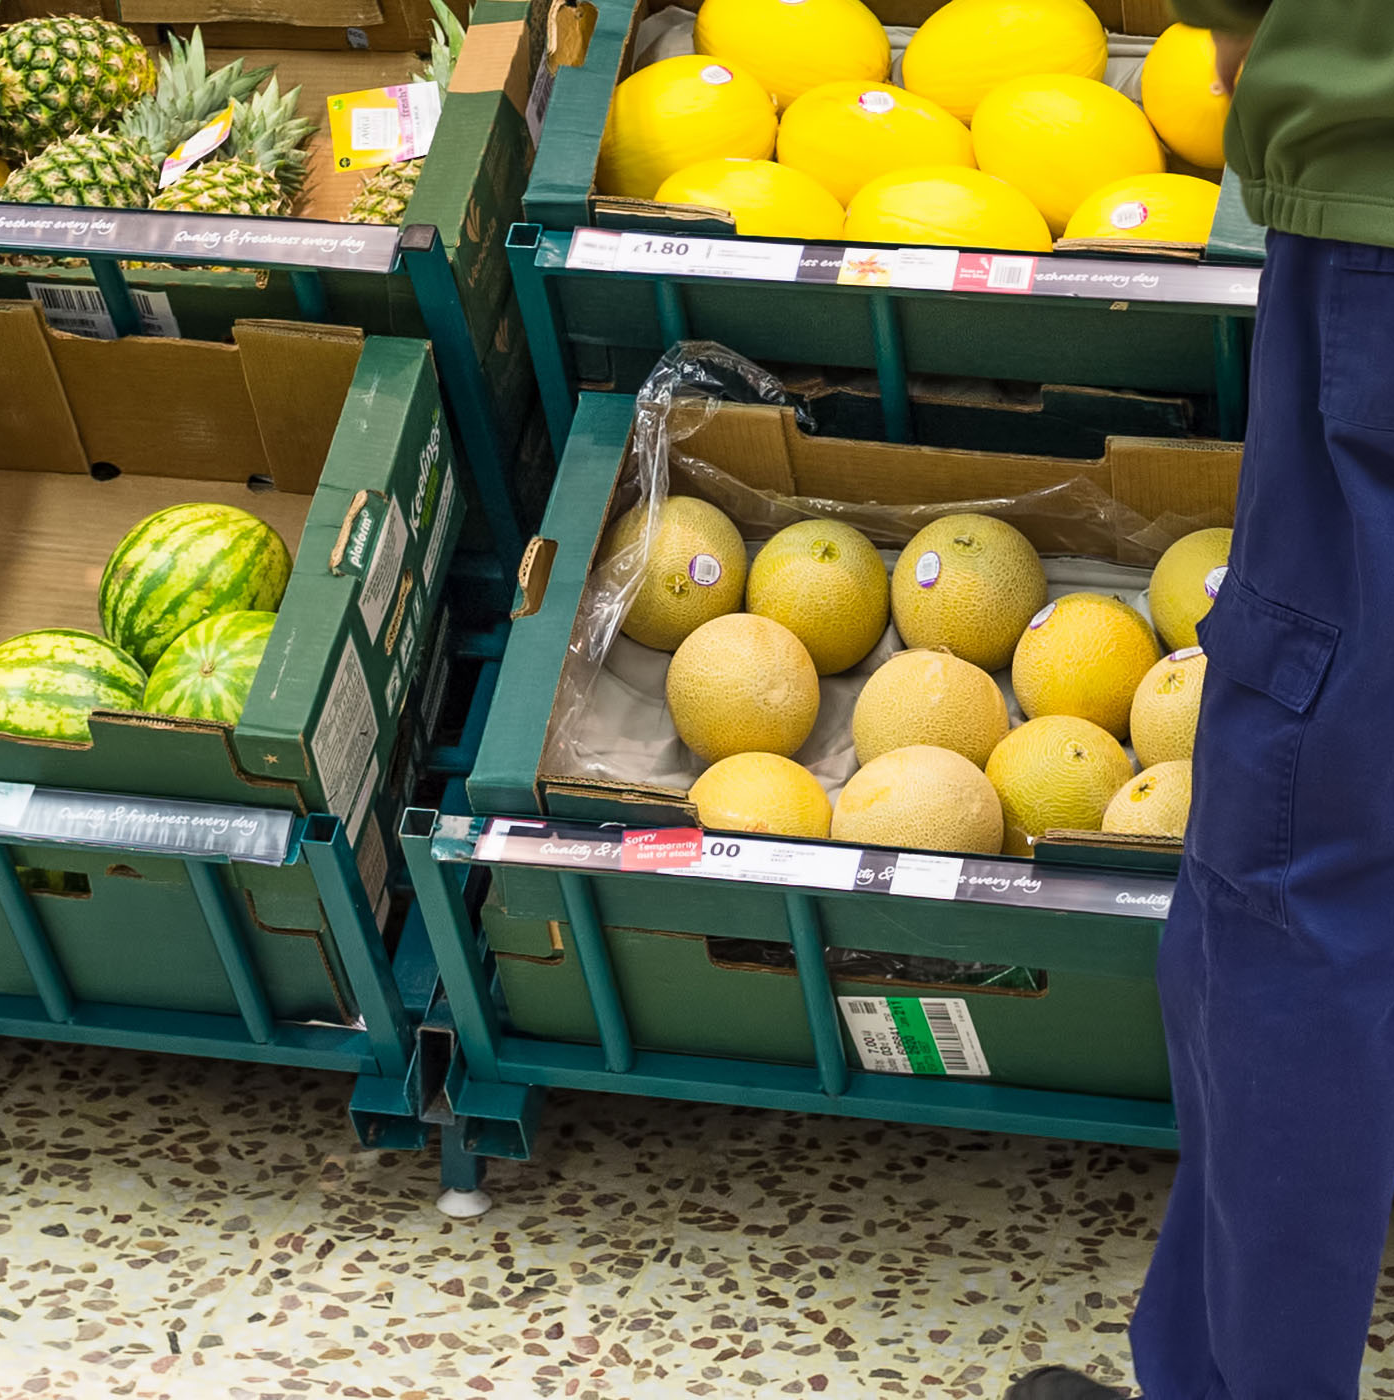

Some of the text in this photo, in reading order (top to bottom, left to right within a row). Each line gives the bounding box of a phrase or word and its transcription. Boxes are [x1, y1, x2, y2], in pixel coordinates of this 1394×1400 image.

[53, 219, 90, 236] every
[91, 219, 117, 236] day
[633, 240, 689, 257] £1.80
[408, 426, 441, 541] Keelings
[623, 832, 657, 847] Sorry
[637, 841, 698, 852] Temporarily
[540, 841, 614, 861] Quality &
[636, 849, 698, 859] out of stock
[964, 873, 1043, 893] every day
[1115, 892, 1171, 912] Quality
